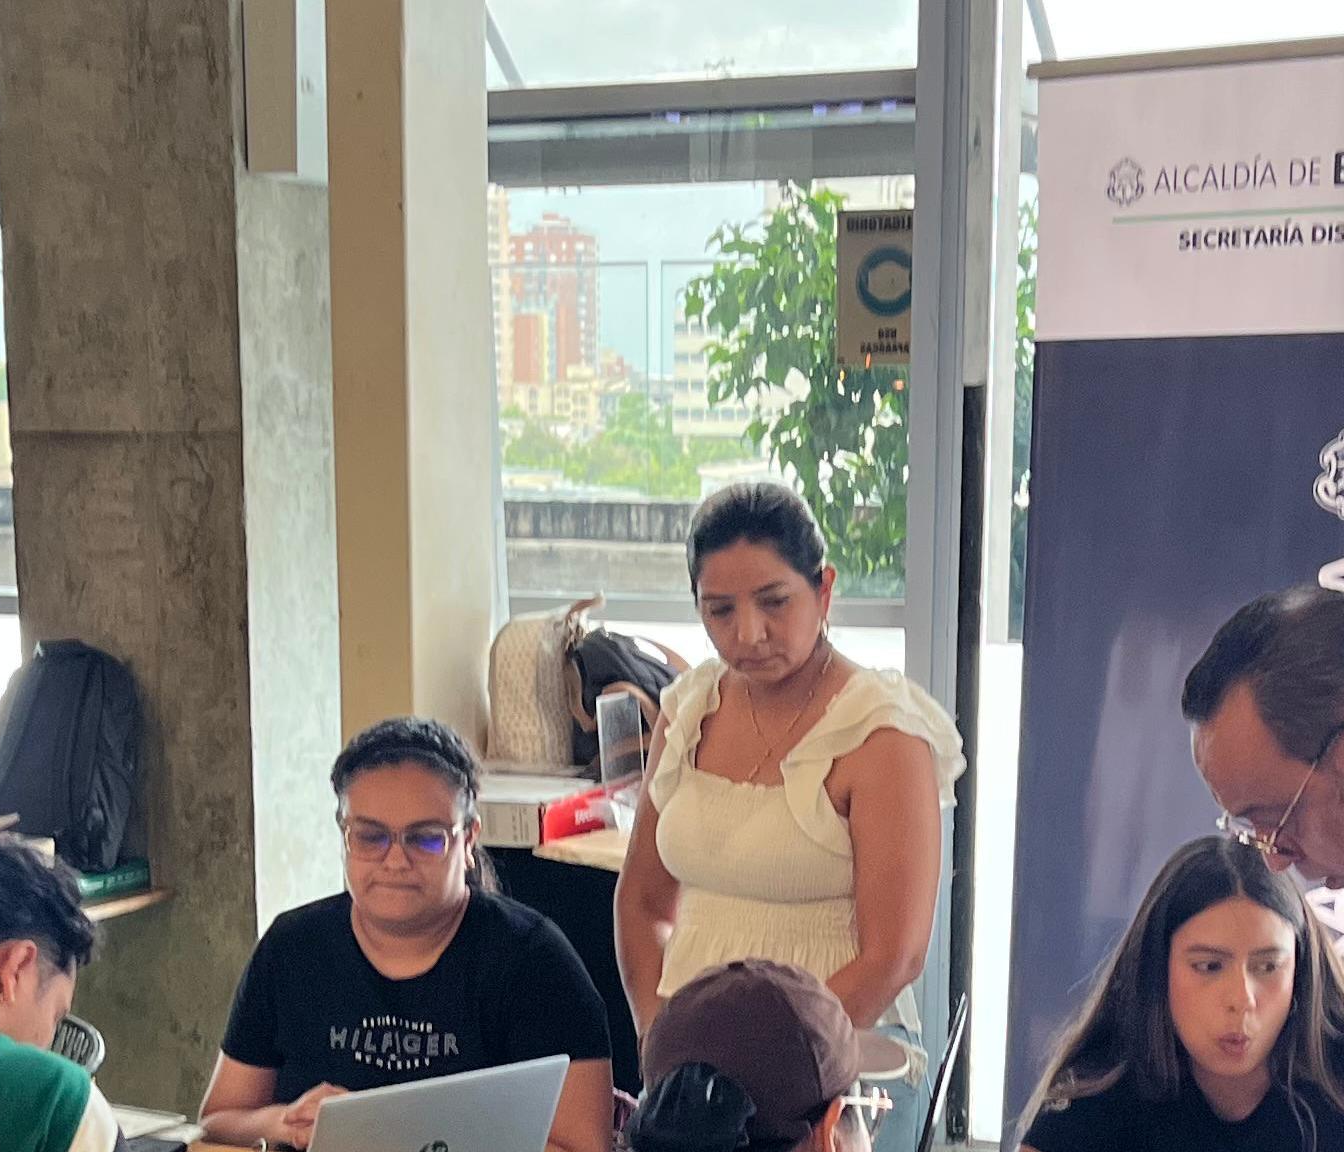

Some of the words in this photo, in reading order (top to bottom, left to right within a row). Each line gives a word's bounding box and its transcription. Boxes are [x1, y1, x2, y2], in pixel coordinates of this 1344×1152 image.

[1153, 152, 1278, 194] ALCALDÍA
[1288, 157, 1321, 187] DE
[1178, 216, 1304, 251] SECRETARÍA
